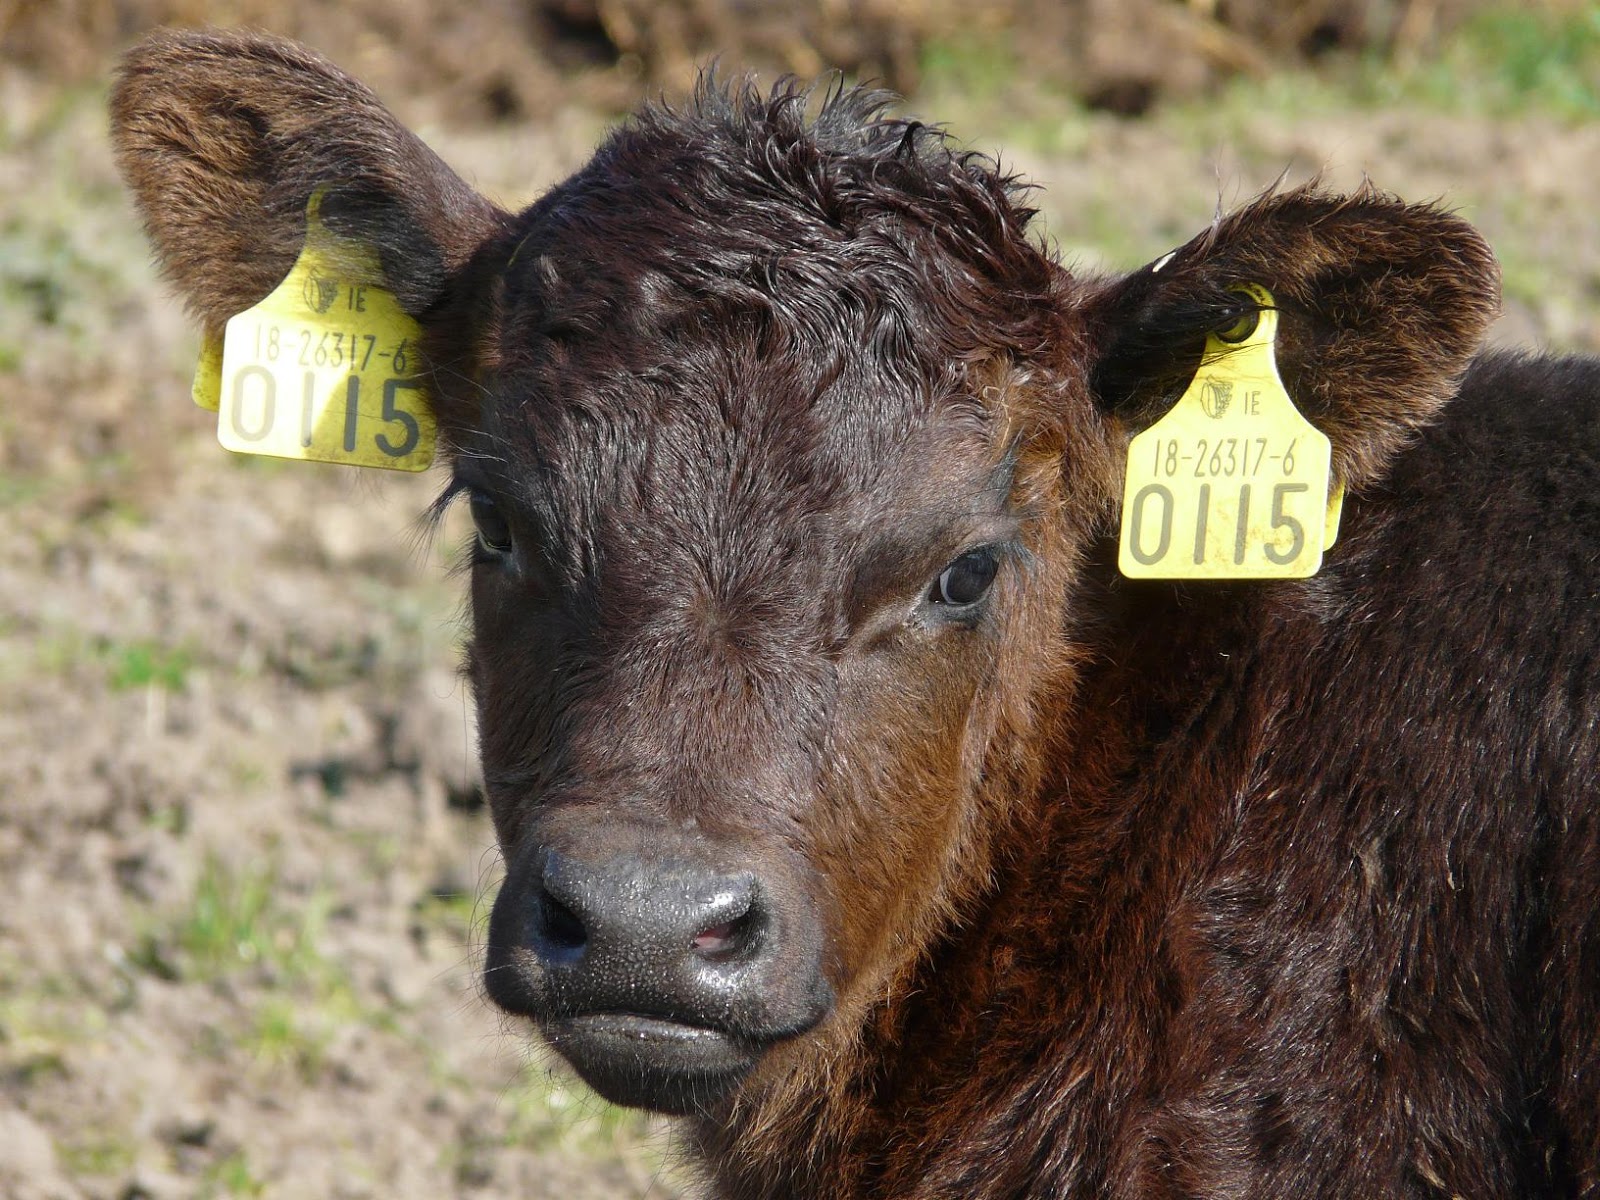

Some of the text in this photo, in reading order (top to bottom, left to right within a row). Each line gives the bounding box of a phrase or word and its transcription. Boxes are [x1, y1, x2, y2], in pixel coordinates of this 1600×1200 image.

[348, 287, 367, 313] IE
[255, 322, 408, 375] 18-26317-6
[231, 364, 426, 458] 0115
[1244, 390, 1261, 416] IE
[1153, 437, 1298, 478] 18-26317-6
[1129, 483, 1309, 566] 0115
